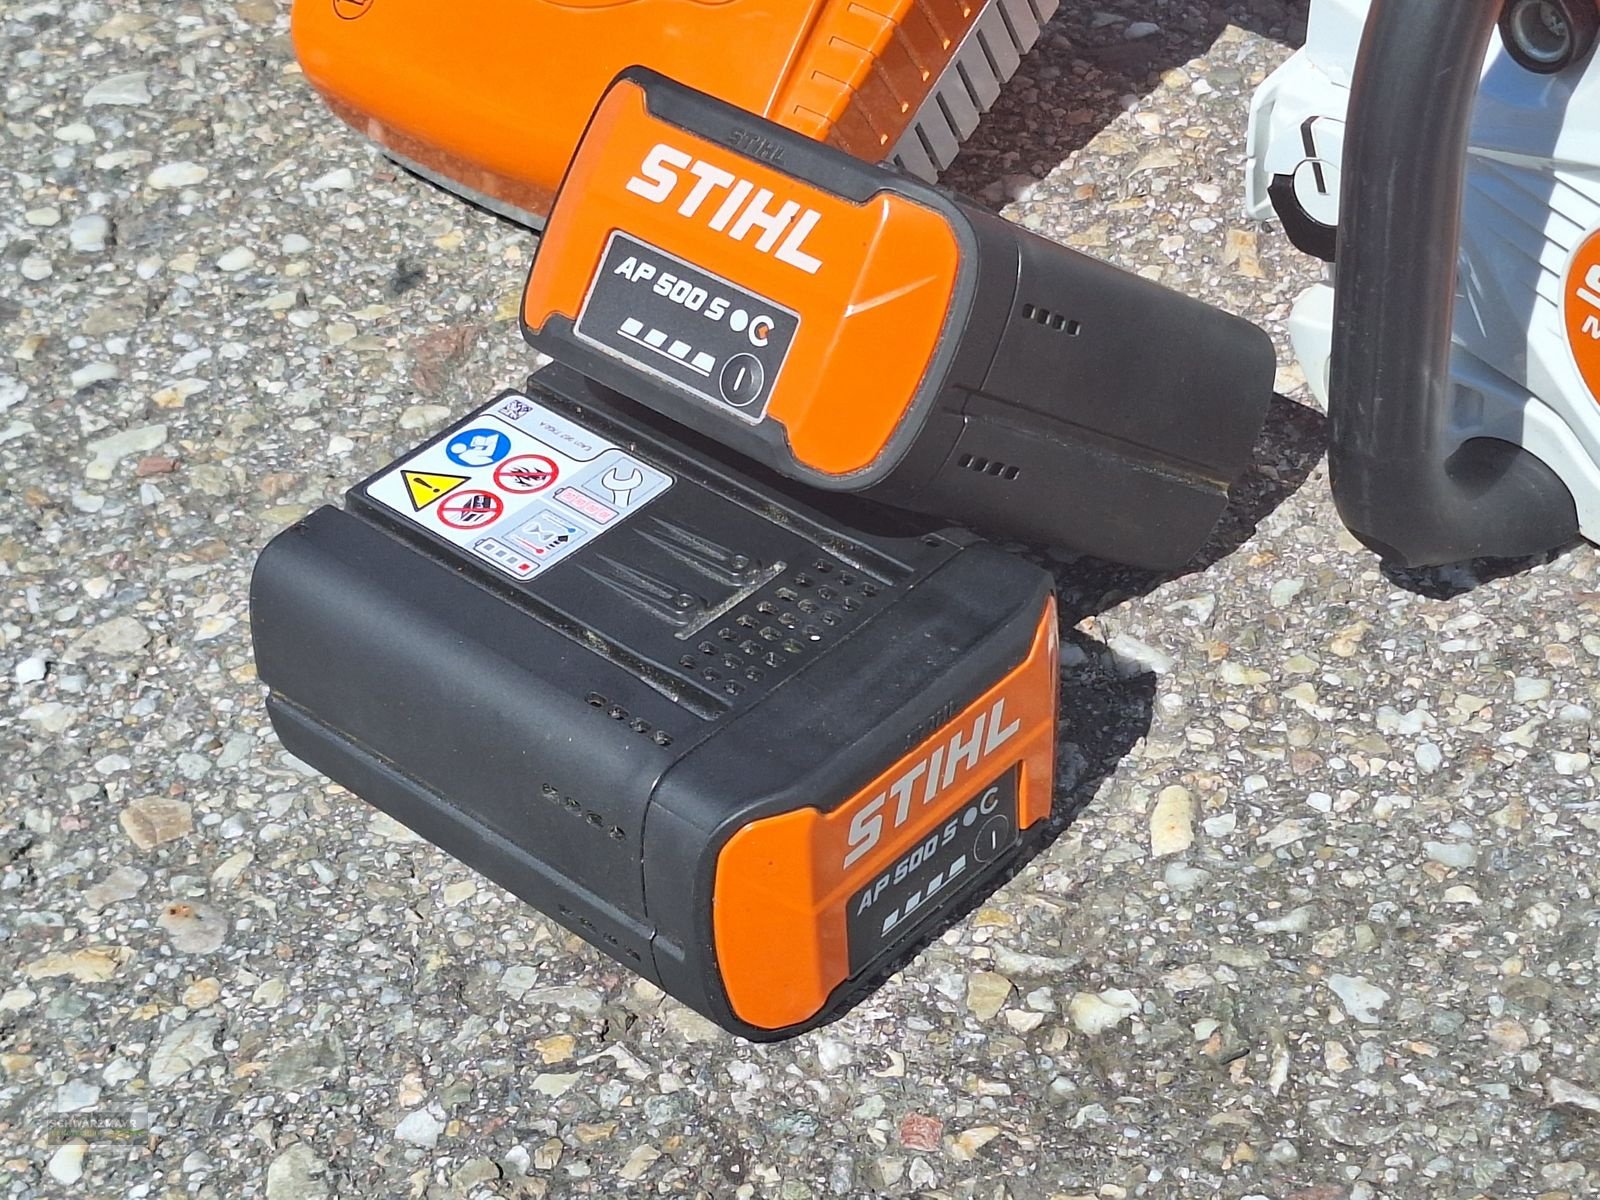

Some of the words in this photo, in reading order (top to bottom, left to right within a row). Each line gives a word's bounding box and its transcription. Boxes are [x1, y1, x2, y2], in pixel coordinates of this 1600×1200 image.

[626, 143, 823, 274] STIHL
[614, 256, 657, 283] AP
[653, 272, 709, 312] 500
[703, 296, 731, 321] S
[843, 698, 1020, 870] STIHL
[857, 874, 890, 916] AP
[893, 834, 939, 885] 500
[941, 818, 959, 847] S
